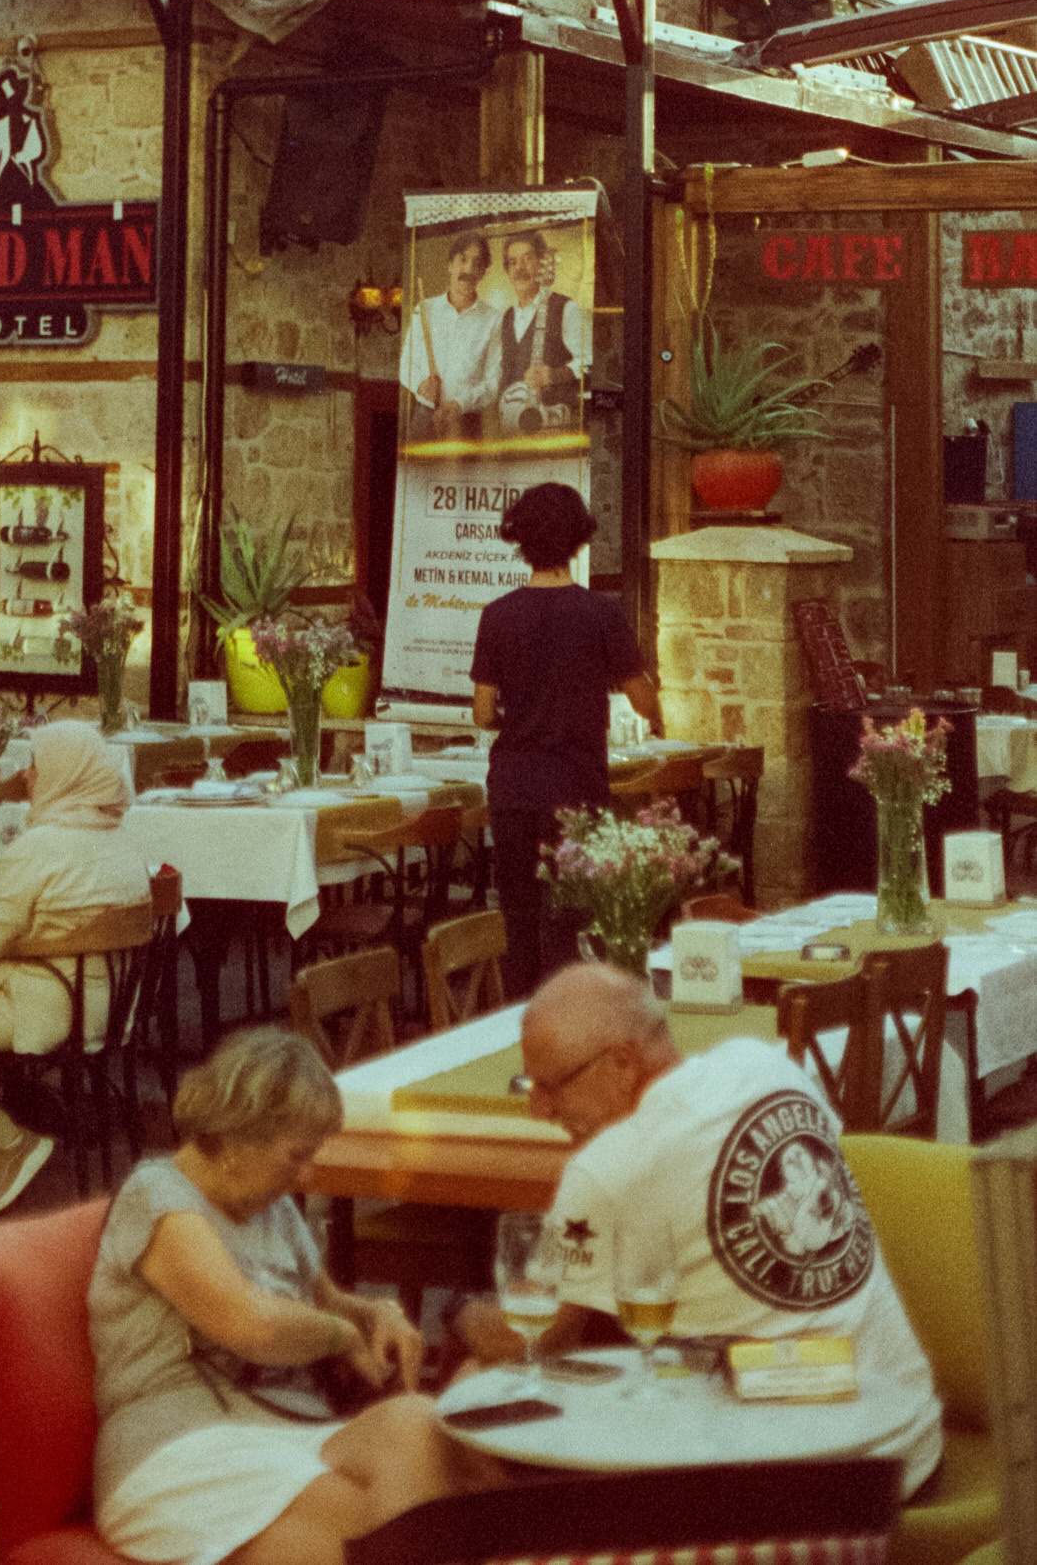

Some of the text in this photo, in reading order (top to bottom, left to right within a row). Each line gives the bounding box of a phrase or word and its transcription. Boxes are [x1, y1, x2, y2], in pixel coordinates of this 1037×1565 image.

[44, 226, 154, 286] MAN
[763, 235, 903, 281] CAFE
[433, 484, 522, 514] 28 HAZİR
[413, 566, 446, 585] METİN
[457, 569, 496, 587] KEMAL
[726, 1103, 828, 1204] LOS ANGELE
